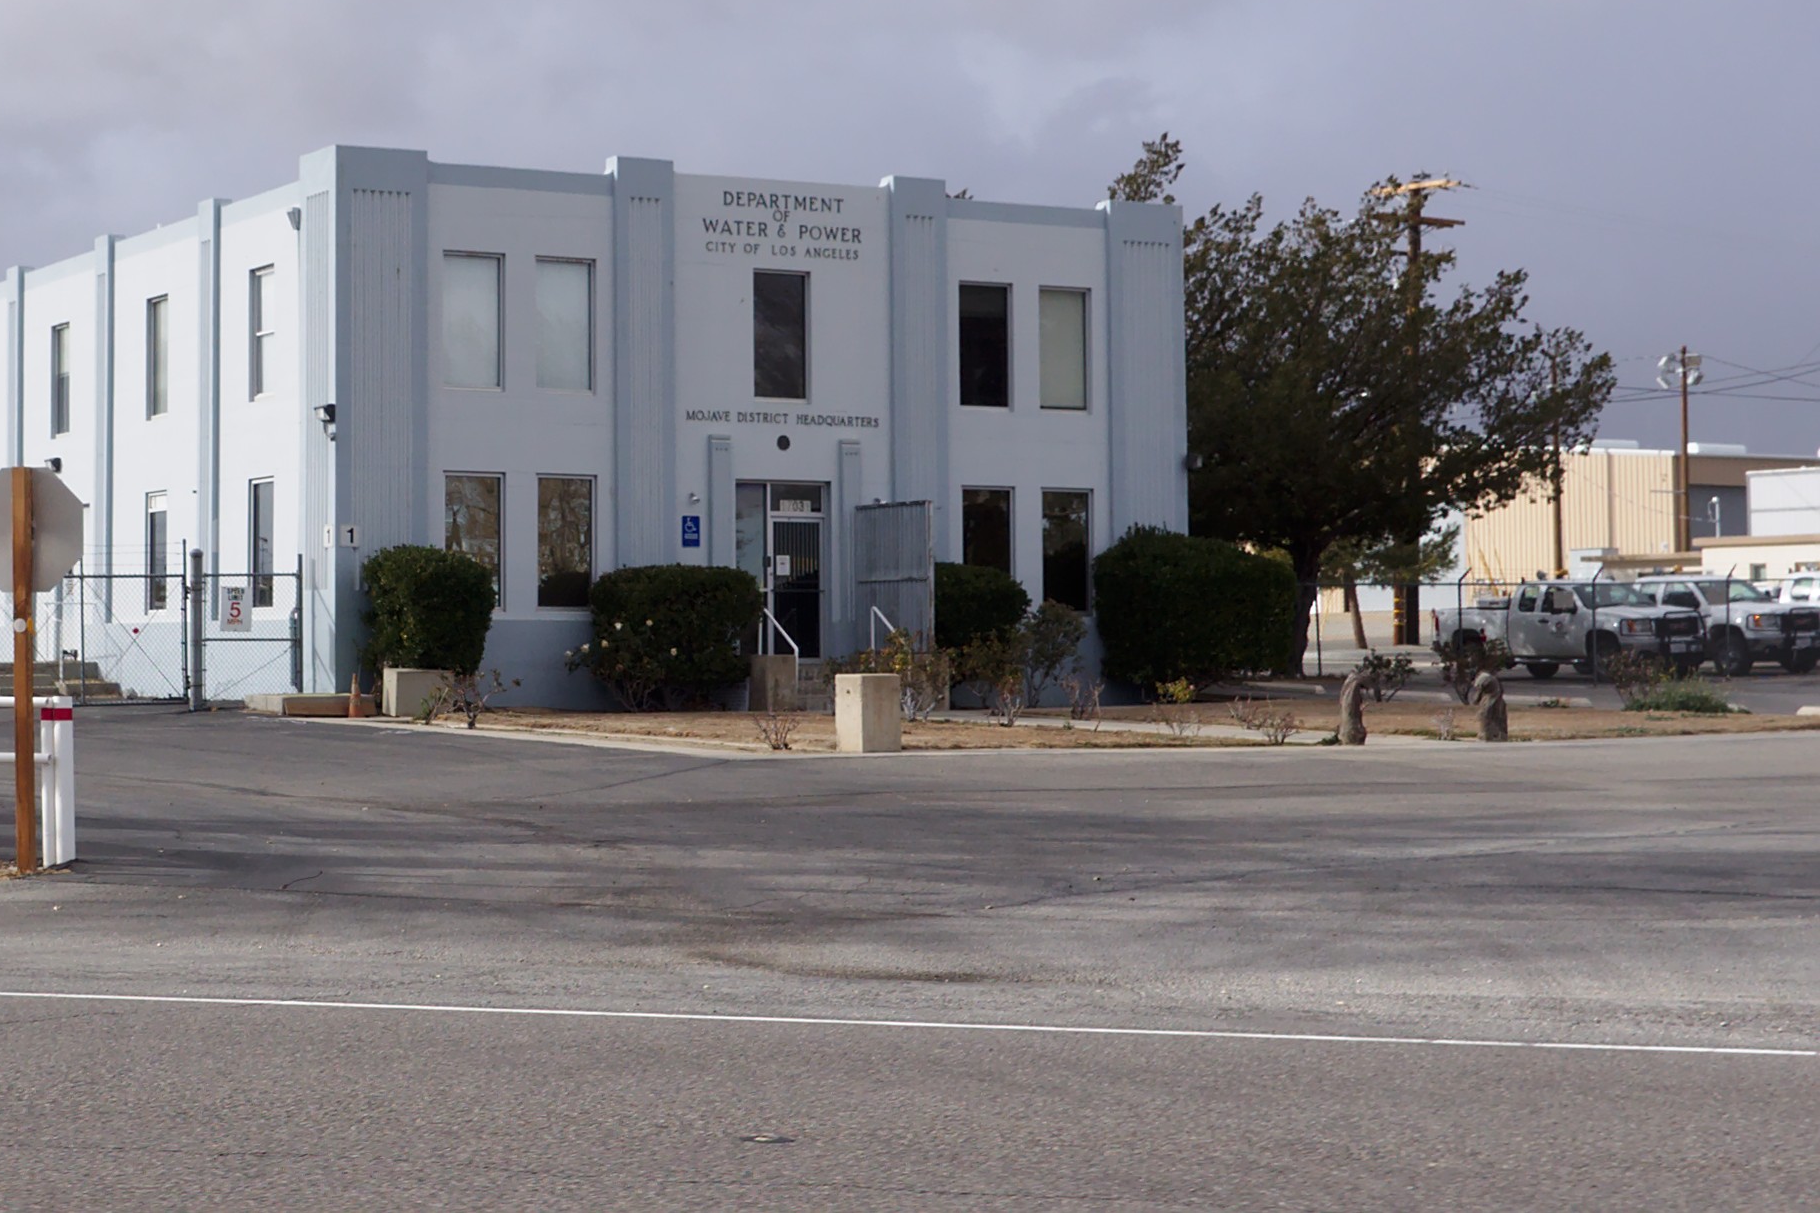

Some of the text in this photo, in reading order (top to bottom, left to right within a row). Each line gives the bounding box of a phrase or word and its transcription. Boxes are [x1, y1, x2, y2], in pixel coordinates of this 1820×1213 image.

[723, 190, 844, 213] DEPARTMENT
[772, 209, 791, 223] OF
[702, 217, 862, 244] WATER & POWER
[705, 241, 859, 260] CITY OF LOS ANGELES
[685, 410, 879, 429] MOJAVE DISTRICT HEADQUARTERS
[346, 527, 354, 544] 1
[229, 601, 241, 618] 5
